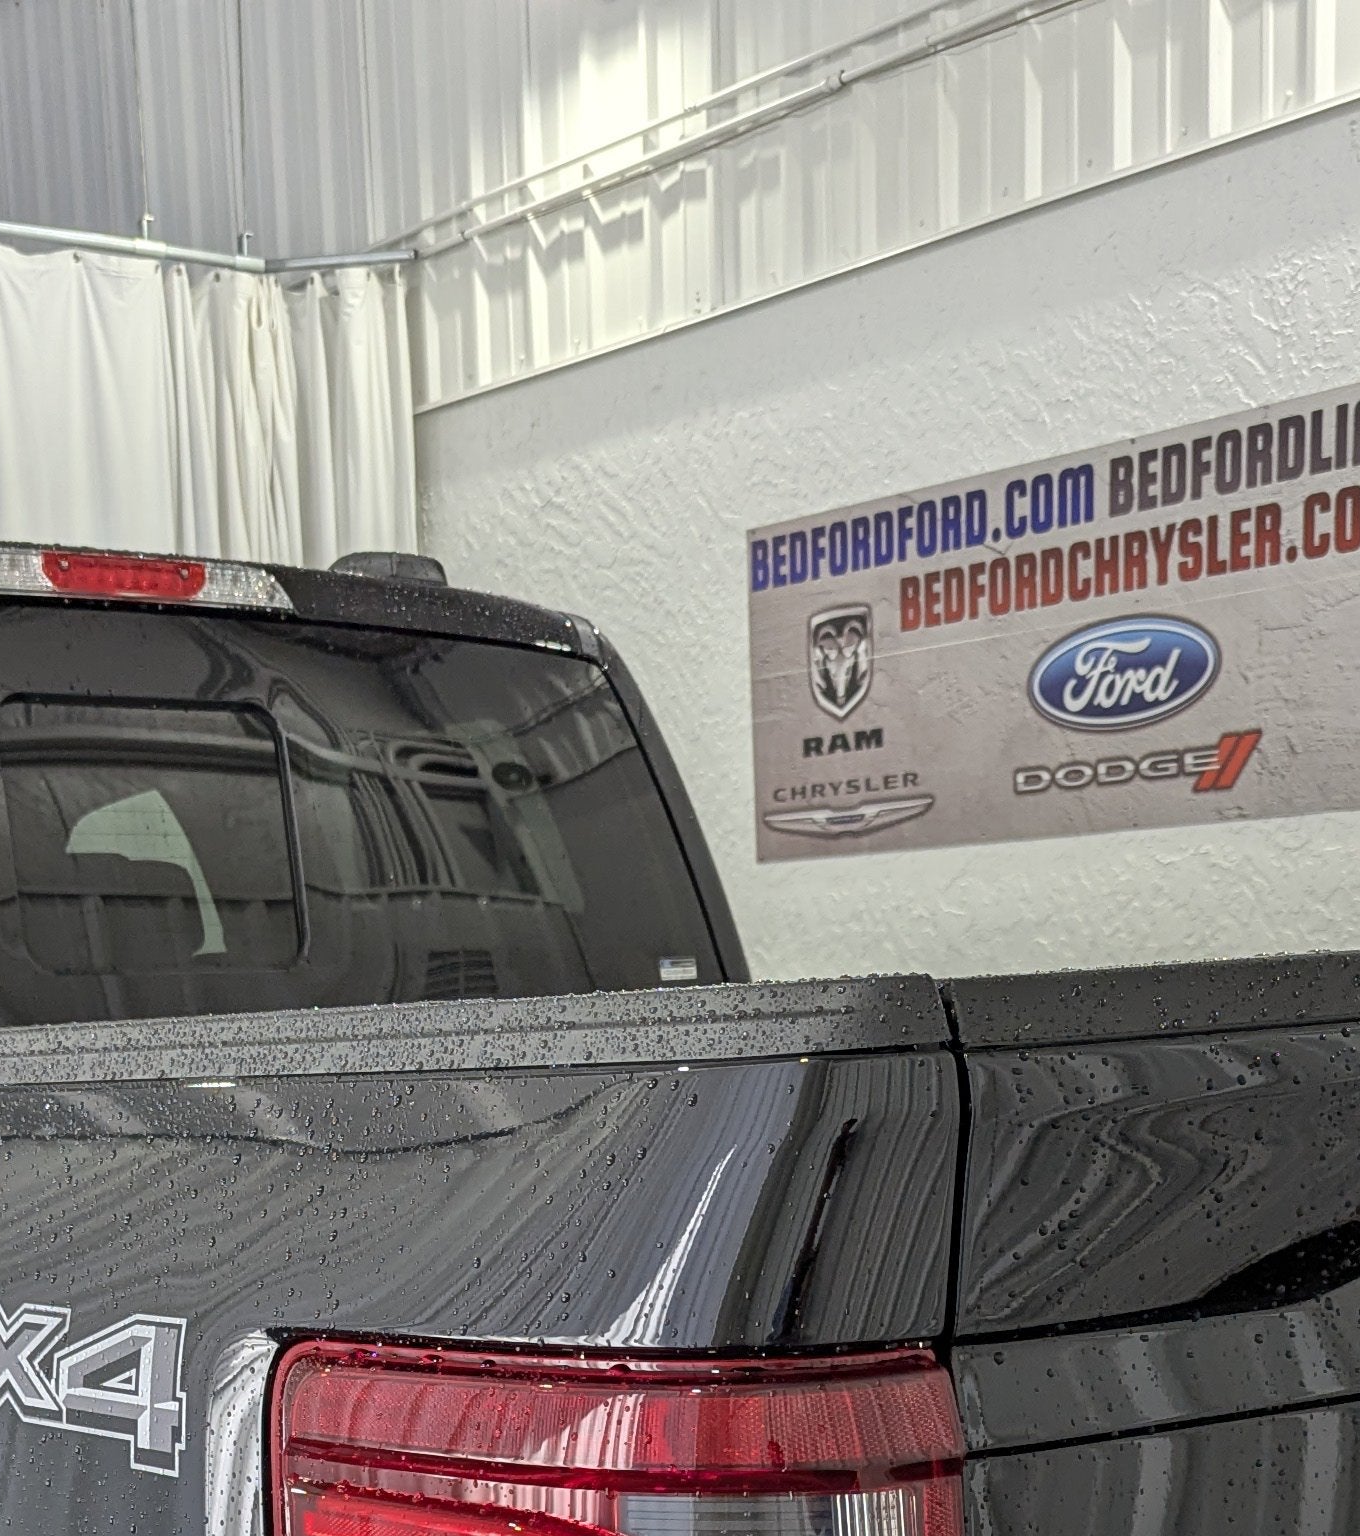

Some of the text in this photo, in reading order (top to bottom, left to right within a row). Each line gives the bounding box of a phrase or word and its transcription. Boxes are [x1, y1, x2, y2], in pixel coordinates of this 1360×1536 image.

[750, 463, 1095, 592] BEDFORDFORD.COM
[1062, 637, 1181, 714] Ford
[802, 728, 884, 759] RAM
[772, 772, 920, 803] CHRYSLER
[1013, 746, 1222, 794] DODGE
